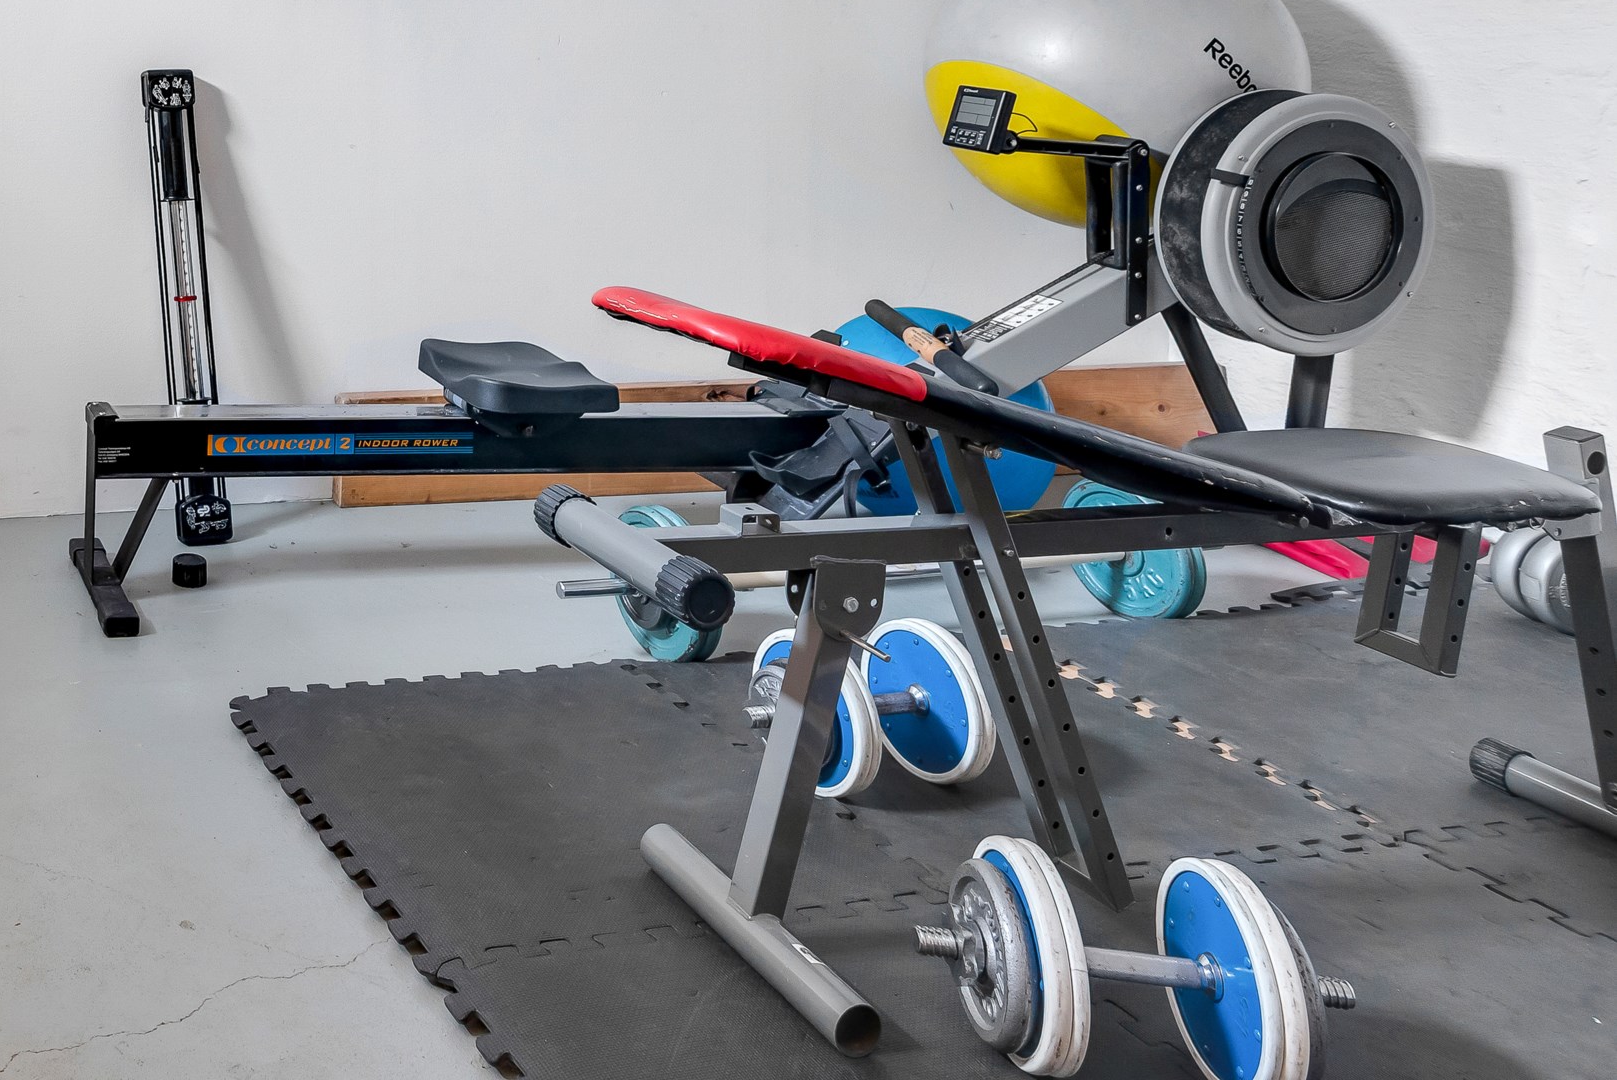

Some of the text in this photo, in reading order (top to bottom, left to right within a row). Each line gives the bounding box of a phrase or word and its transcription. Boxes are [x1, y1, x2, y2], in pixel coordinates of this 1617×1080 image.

[246, 437, 459, 452] concept 2 INDOOR ROWER
[1122, 568, 1165, 601] 5KG
